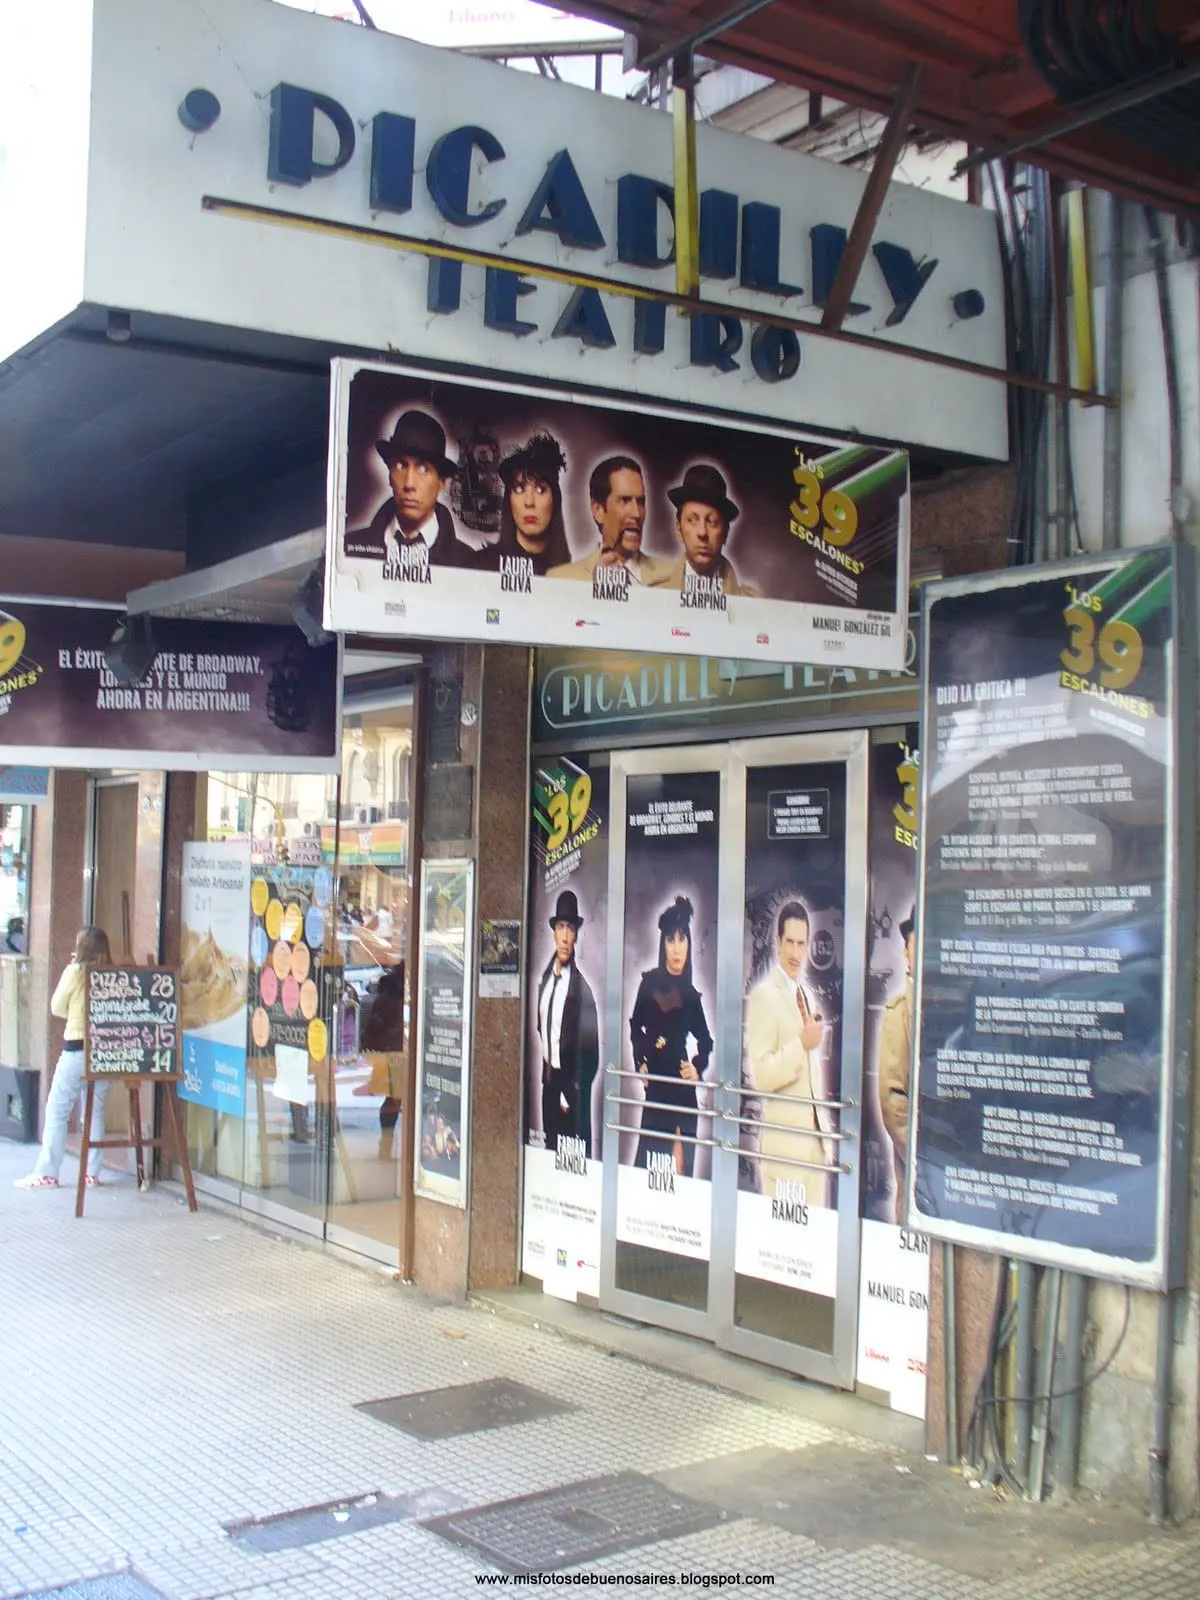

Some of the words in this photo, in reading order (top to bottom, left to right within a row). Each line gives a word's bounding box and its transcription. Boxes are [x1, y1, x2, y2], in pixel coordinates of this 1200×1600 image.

[267, 82, 940, 328] PICADILLY
[427, 240, 801, 384] TEATRO
[789, 466, 859, 547] 39
[382, 563, 432, 585] GIANOLA
[499, 555, 534, 577] LAURA
[596, 566, 626, 585] DIEGO
[500, 575, 532, 594] OLIVA
[592, 583, 629, 602] RAMOS
[680, 592, 727, 612] SCARPINO
[880, 624, 891, 638] GIL
[58, 649, 73, 669] EL
[179, 652, 194, 672] DE
[1059, 607, 1144, 690] 39
[156, 671, 165, 689] Y
[168, 671, 182, 690] EL
[184, 672, 227, 691] MUNDO
[97, 689, 142, 710] AHORA
[145, 690, 163, 710] EN
[936, 686, 958, 705] DIJO
[960, 684, 972, 703] LA
[546, 775, 592, 851] 39
[150, 973, 174, 998] 28
[158, 1000, 177, 1024] 20
[150, 1050, 172, 1073] 14
[646, 1150, 677, 1175] LAURA
[648, 1169, 676, 1195] OLIVA
[774, 1178, 806, 1203] DIEGO
[771, 1199, 809, 1226] RAMOS
[898, 1229, 929, 1256] SCAR
[867, 1279, 906, 1306] MANUEL
